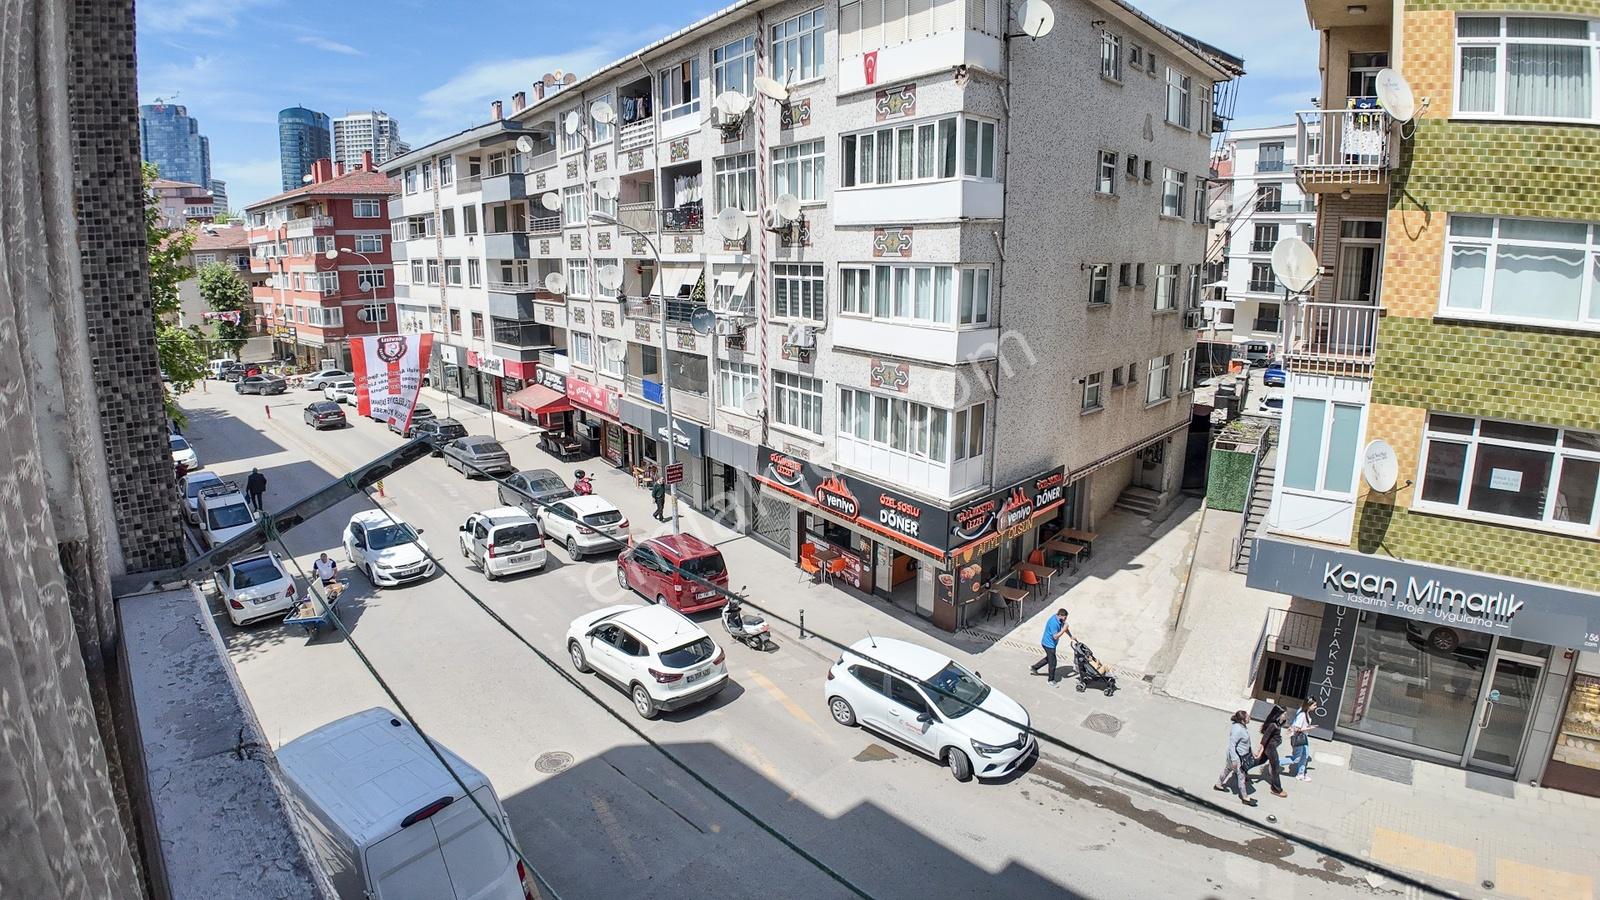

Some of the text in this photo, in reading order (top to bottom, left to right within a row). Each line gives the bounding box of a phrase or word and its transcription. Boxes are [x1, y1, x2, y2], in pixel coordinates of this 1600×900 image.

[826, 493, 855, 514] yeniyo
[1036, 486, 1061, 507] DÖNER
[879, 508, 919, 536] DÖNER
[1007, 504, 1032, 526] yeniyo
[1323, 561, 1525, 621] Kaan Mimarlık
[1396, 601, 1425, 617] Proje
[1434, 607, 1493, 628] Uygulama
